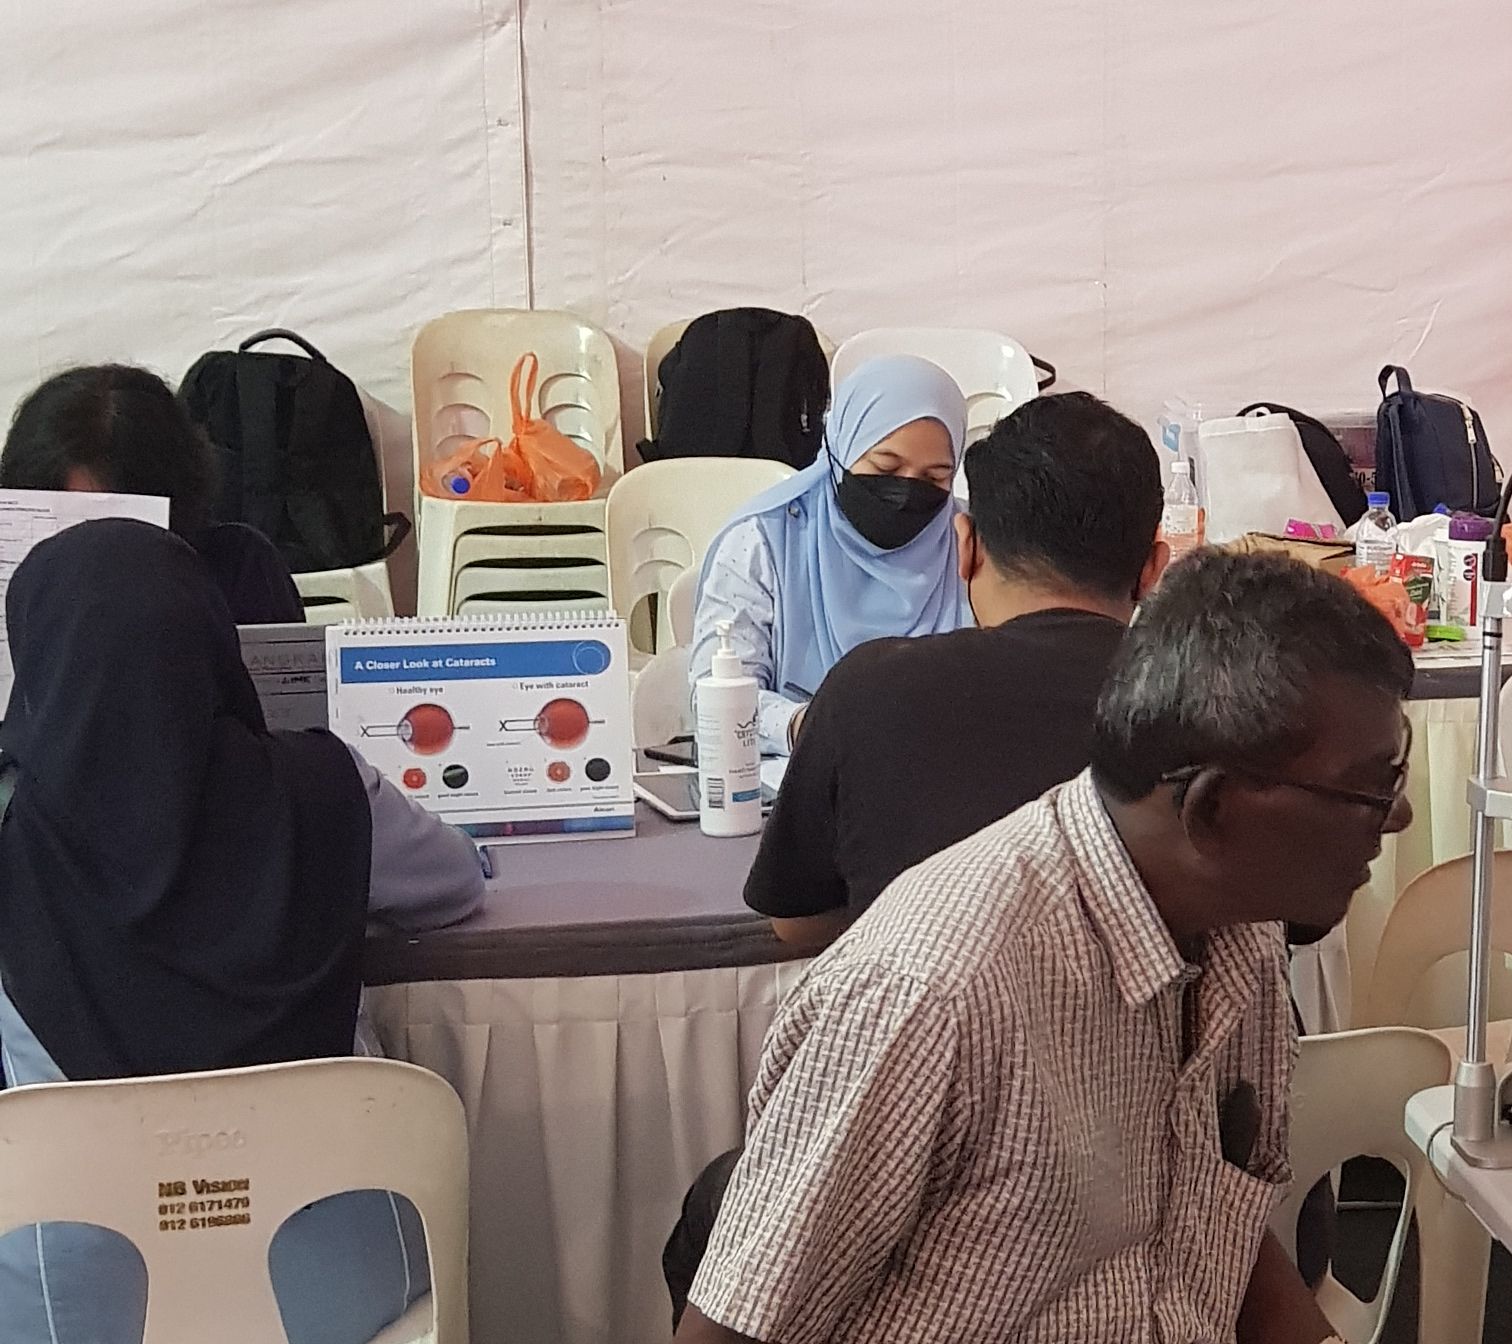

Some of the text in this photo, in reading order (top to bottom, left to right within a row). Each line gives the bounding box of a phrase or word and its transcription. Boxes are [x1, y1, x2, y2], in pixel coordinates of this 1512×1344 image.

[354, 657, 497, 671] A Closer Look at Cataracts
[396, 686, 444, 696] Healthy eye
[520, 681, 589, 691] Eye with cataract
